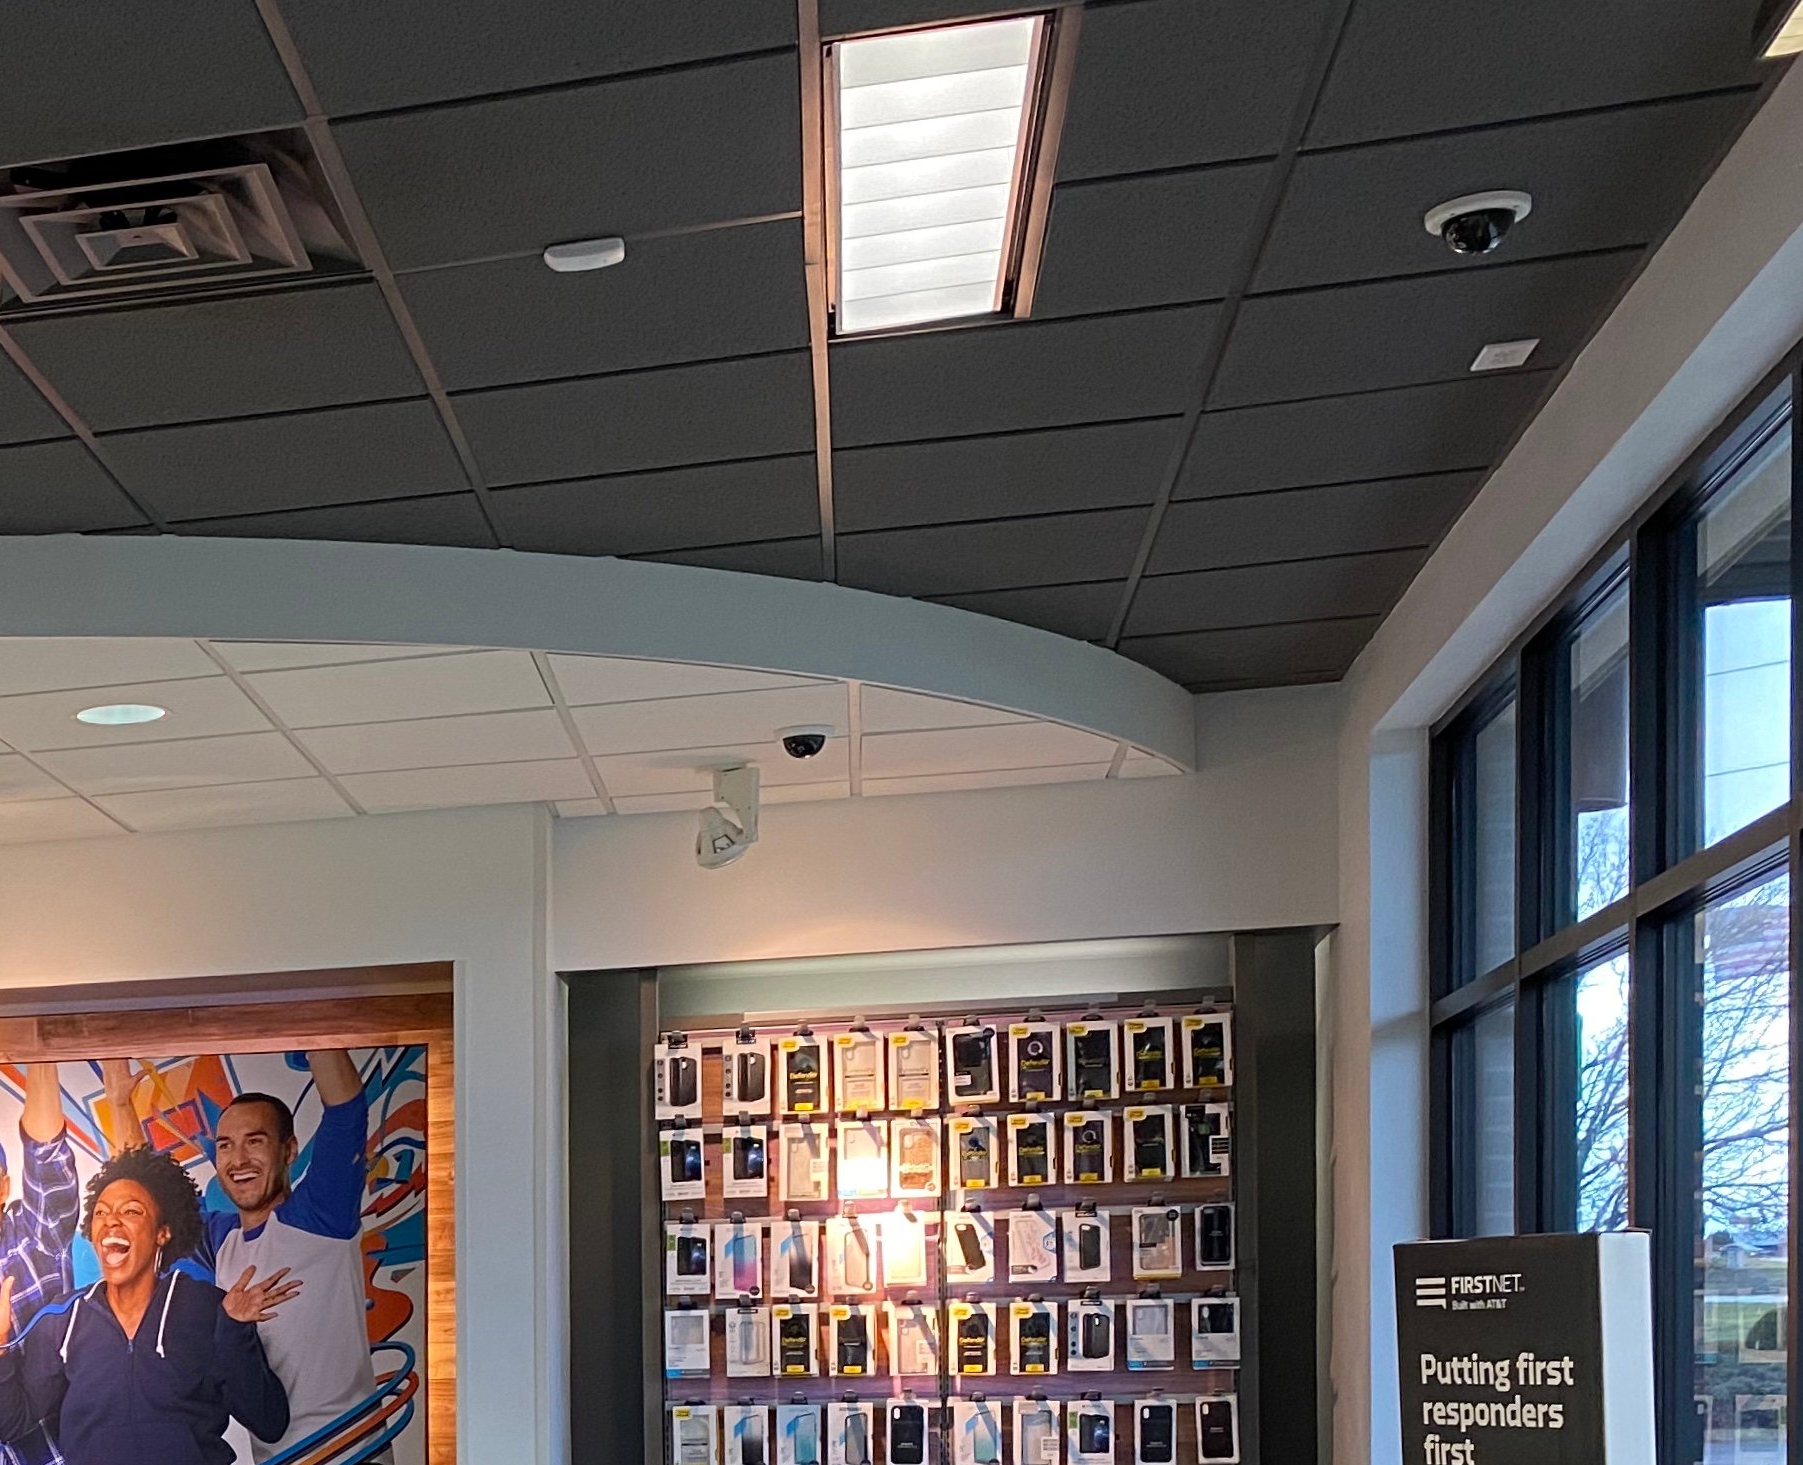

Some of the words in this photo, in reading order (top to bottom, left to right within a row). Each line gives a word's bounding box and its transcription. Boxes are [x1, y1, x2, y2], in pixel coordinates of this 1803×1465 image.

[1421, 1353, 1511, 1392] Putting
[1516, 1352, 1574, 1385] first
[1423, 1394, 1564, 1433] responders
